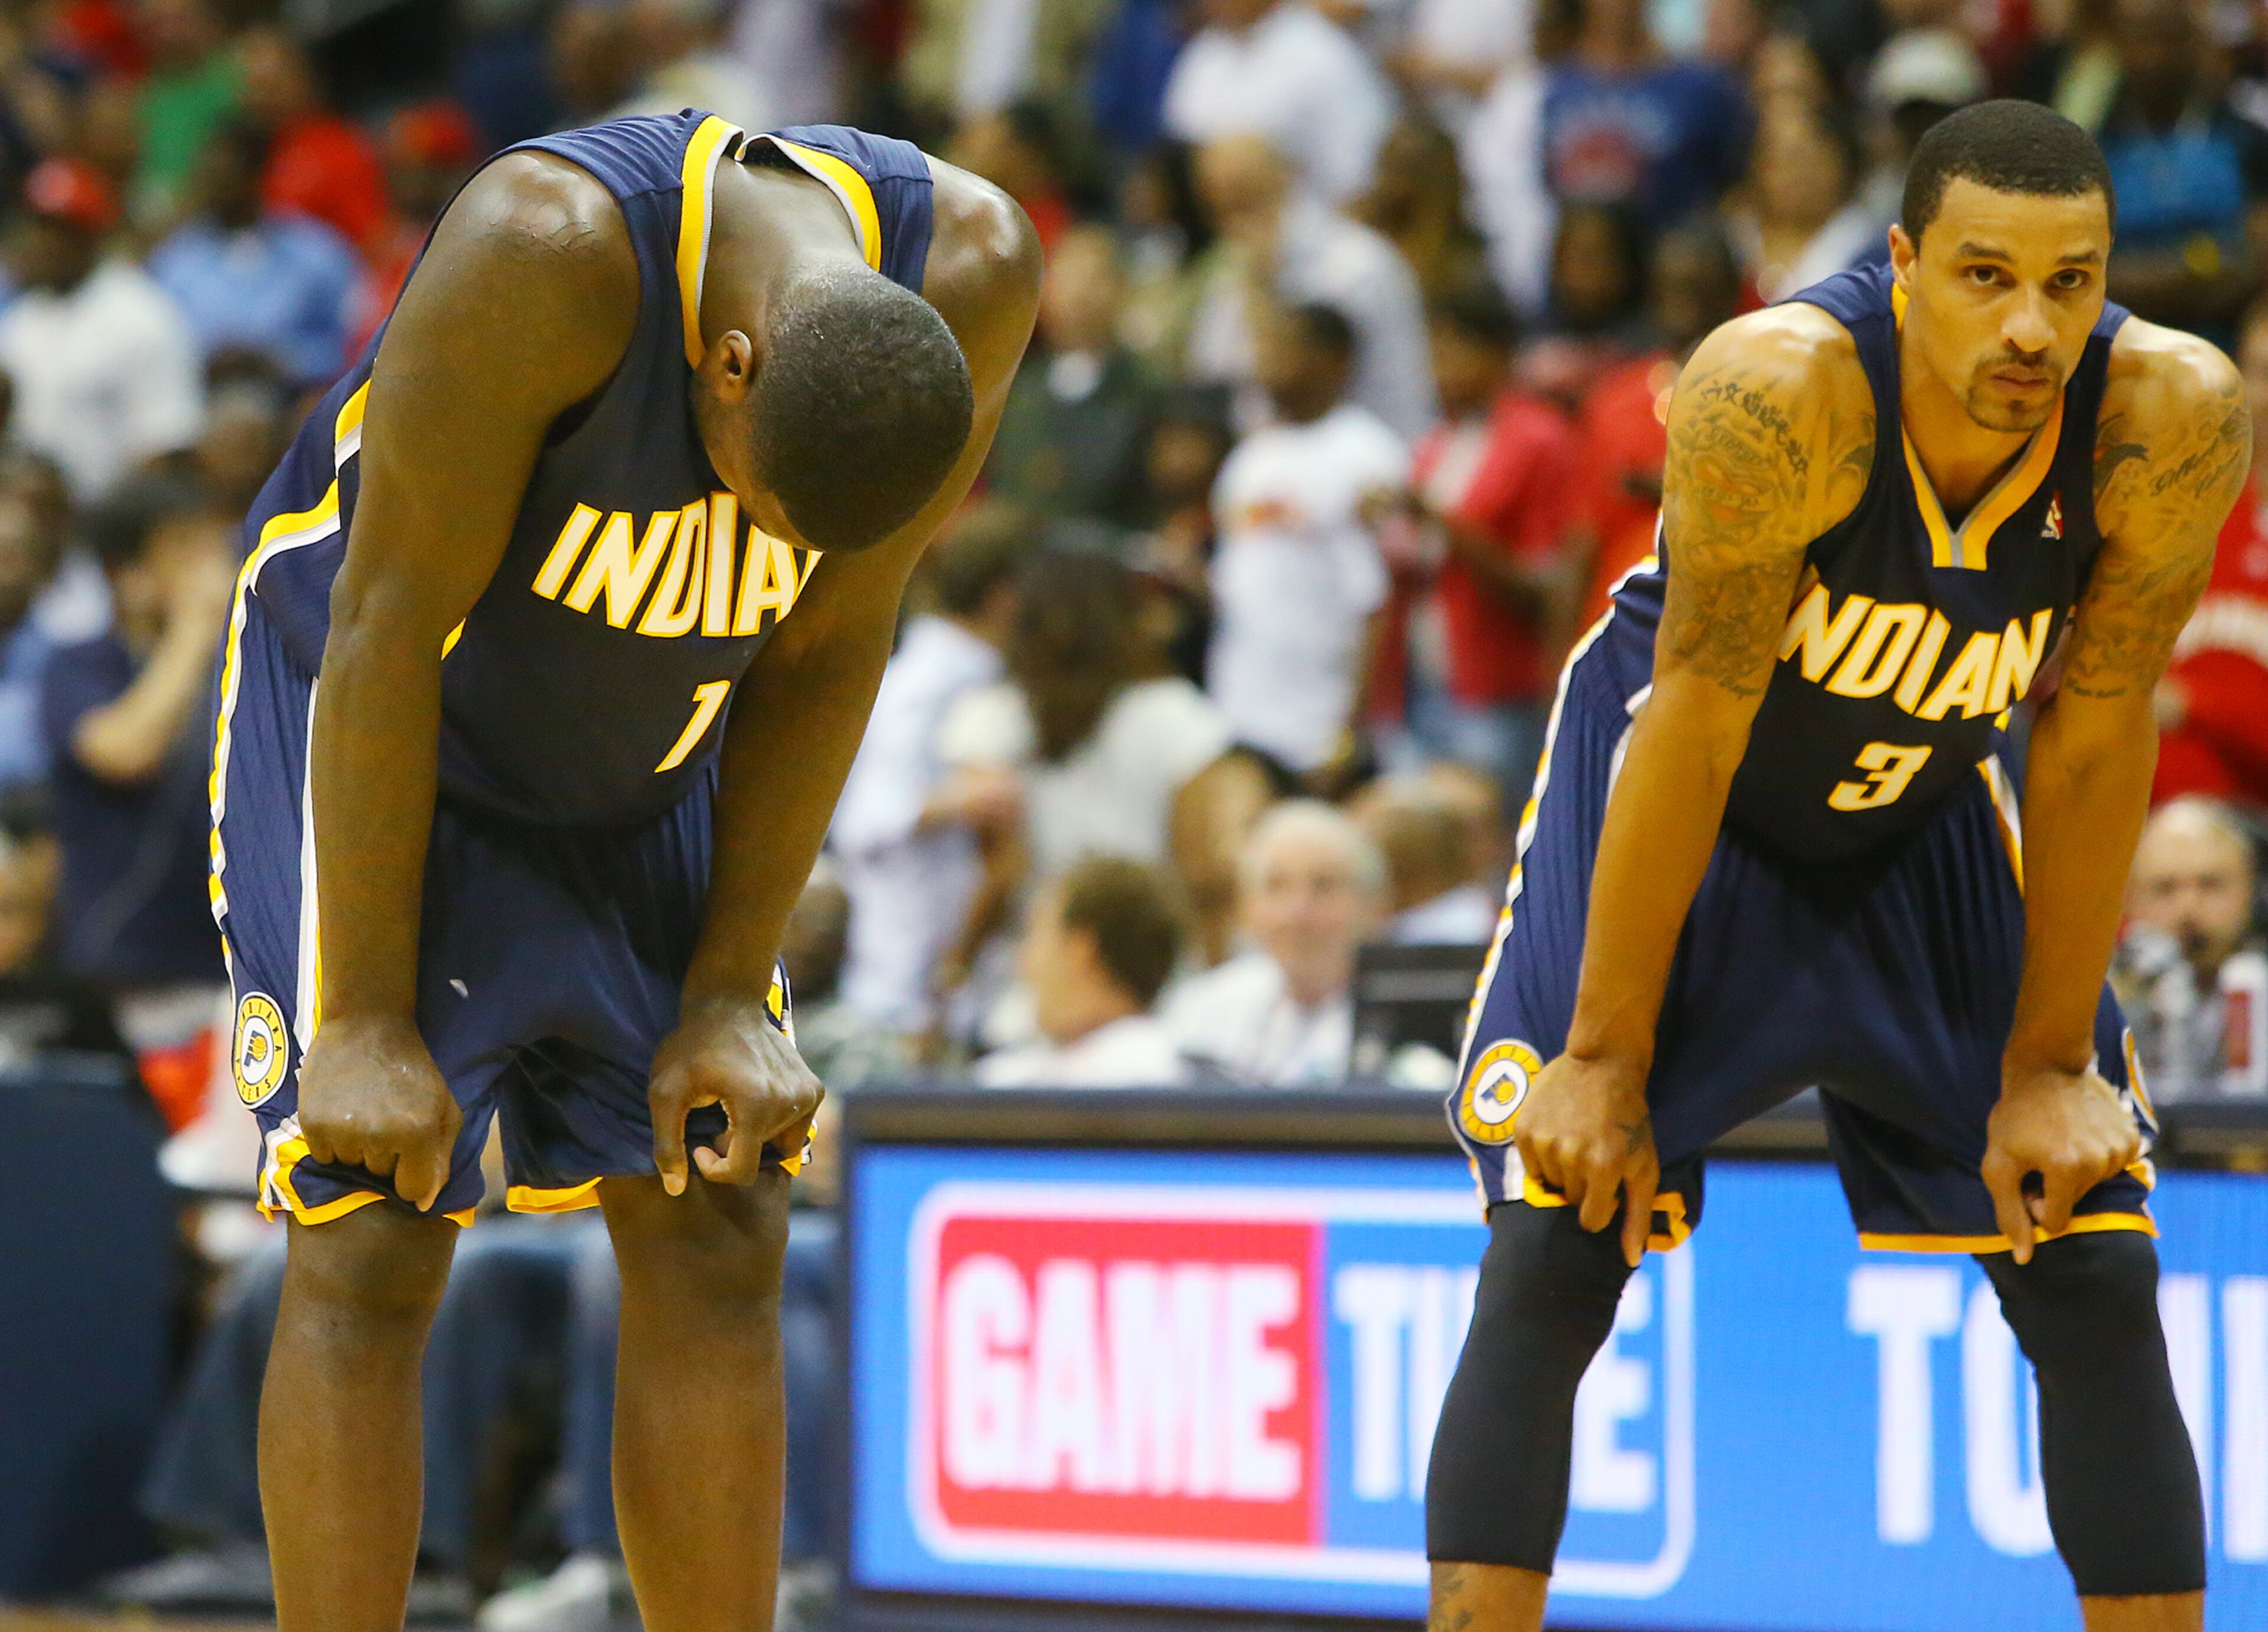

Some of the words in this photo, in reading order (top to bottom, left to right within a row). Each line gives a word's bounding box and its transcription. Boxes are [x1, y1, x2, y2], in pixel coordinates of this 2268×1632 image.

[532, 491, 823, 637] INDIA
[654, 680, 731, 773] 1
[1827, 741, 1933, 812] 3
[945, 1253, 1302, 1503] GAME
[1334, 1263, 1654, 1513] TIE
